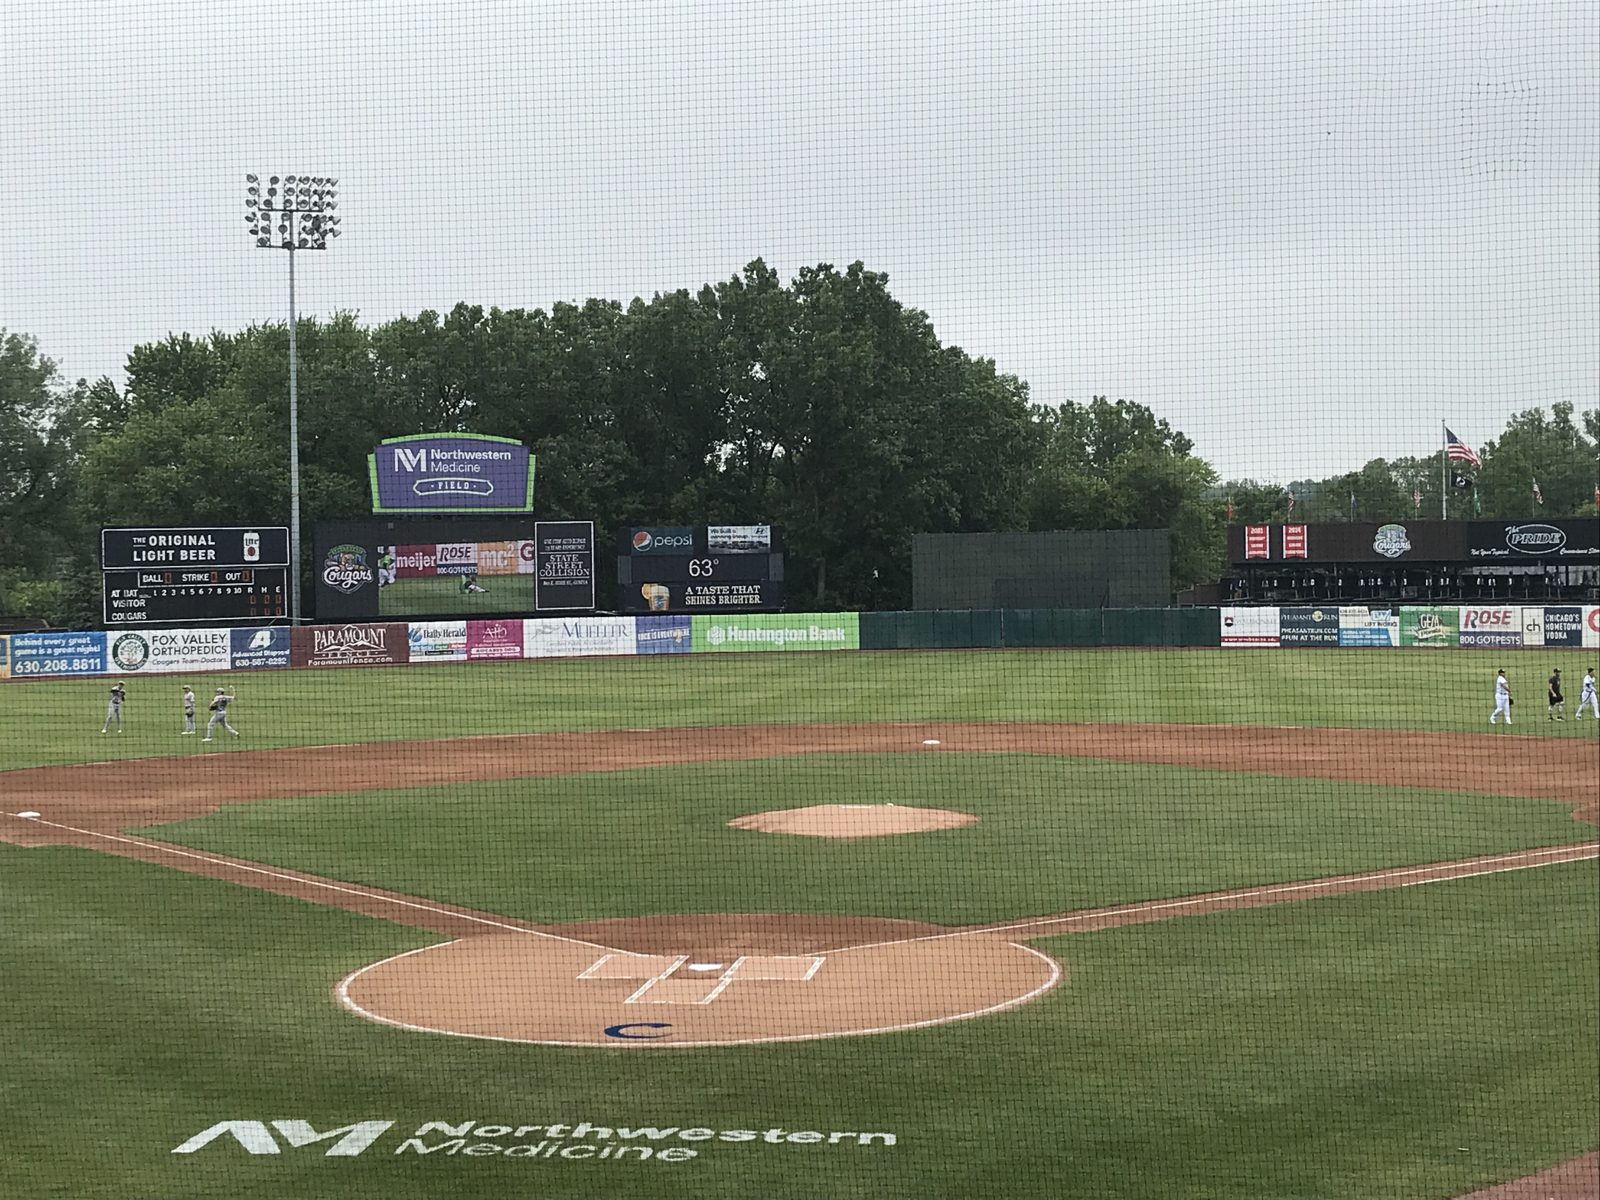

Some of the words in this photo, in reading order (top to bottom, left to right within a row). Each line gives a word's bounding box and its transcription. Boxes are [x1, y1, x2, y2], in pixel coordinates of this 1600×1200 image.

[430, 448, 512, 460] Northwestern
[430, 462, 480, 472] Medicine
[438, 481, 469, 490] FIELD
[148, 535, 216, 546] ORIGINAL
[654, 534, 692, 547] pepsi
[1512, 533, 1562, 544] PRIDE
[133, 550, 175, 562] LIGHT
[180, 550, 216, 560] BEER
[440, 546, 472, 561] ROSE
[396, 551, 436, 570] meijer
[545, 561, 583, 569] STREET
[182, 573, 209, 582] STRIKE
[225, 572, 241, 580] OUT
[324, 566, 373, 588] Cougars
[539, 568, 589, 576] COLLISION
[111, 590, 120, 598] AT
[685, 586, 694, 594] A
[696, 586, 730, 594] TASTE
[731, 585, 761, 594] THAT
[112, 599, 146, 607] VISITOR
[685, 595, 716, 605] SHINES
[112, 612, 147, 620] COUGARS
[1464, 610, 1512, 629] ROSE
[1545, 614, 1580, 622] CHICAGO'S
[563, 622, 628, 638] MUELLER
[1526, 619, 1540, 632] ch
[1545, 622, 1582, 630] HOMETOWN
[424, 629, 442, 638] Daily
[443, 627, 466, 637] Herald
[726, 626, 808, 645] Huntington
[809, 625, 846, 641] Bank
[15, 637, 42, 646] Behind
[152, 634, 178, 645] FOX
[182, 633, 227, 644] VALLEY
[314, 628, 386, 651] PARAMOUNT
[15, 648, 37, 657] game
[53, 646, 76, 656] great
[152, 645, 227, 656] ORTHOPEDICS
[15, 658, 101, 673] 630.208.8811
[604, 1023, 672, 1039] C
[412, 1119, 898, 1147] Northwestern
[392, 1137, 699, 1163] Medicine
